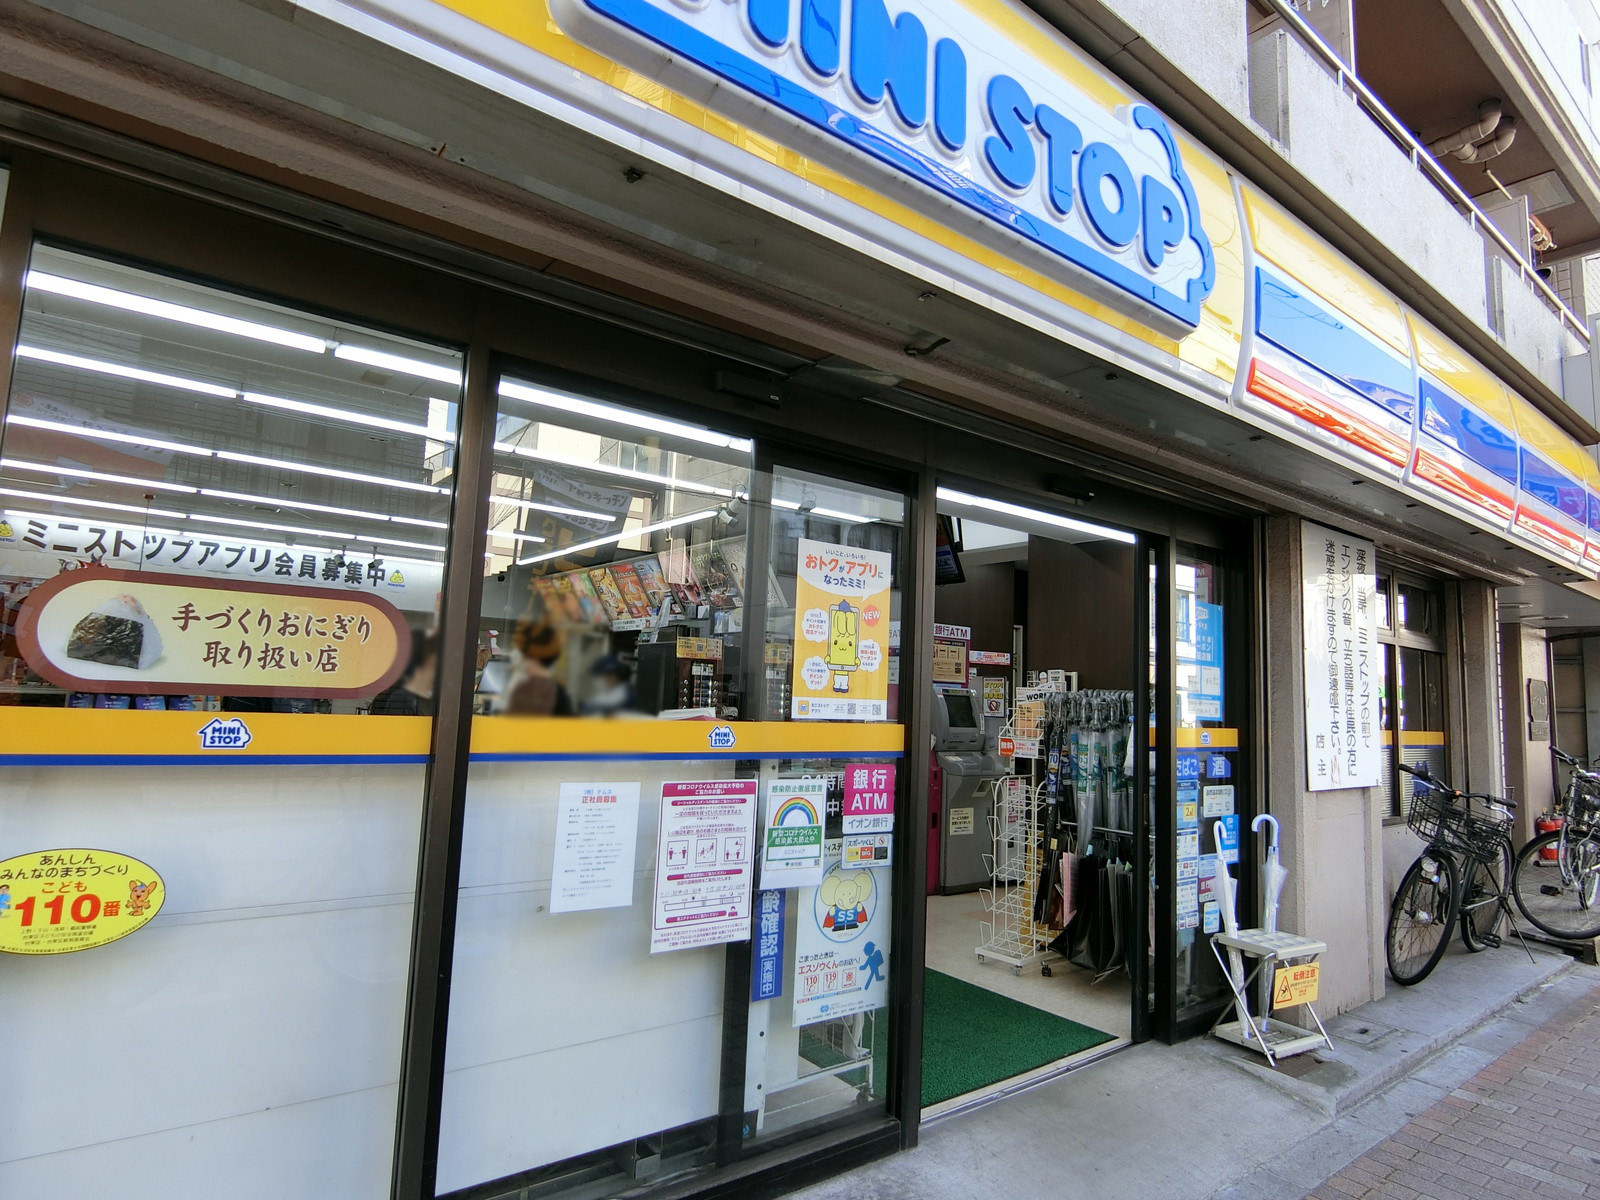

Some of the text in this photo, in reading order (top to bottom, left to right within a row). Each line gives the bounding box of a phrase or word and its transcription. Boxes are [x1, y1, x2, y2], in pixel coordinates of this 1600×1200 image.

[984, 74, 1185, 268] STOP
[22, 519, 386, 588] ミニストップアプリ会員募集中
[862, 609, 881, 620] NEW
[171, 602, 372, 643] 手づくりおにぎり
[202, 640, 340, 673] 取り扱い店
[212, 726, 240, 735] MINI
[209, 735, 241, 744] STOP
[1049, 753, 1059, 764] 70
[1212, 757, 1225, 776] 酒
[853, 768, 887, 790] 銀行
[851, 792, 888, 811] ATM
[848, 817, 888, 830] イオン銀行
[847, 838, 874, 848] スポーツくじ
[40, 853, 96, 866] あんしん
[0, 864, 129, 880] みんなのまちづくり
[42, 881, 87, 894] こども
[15, 893, 121, 927] 110番
[837, 910, 854, 922] SS
[805, 976, 818, 985] 110
[825, 972, 837, 981] 119
